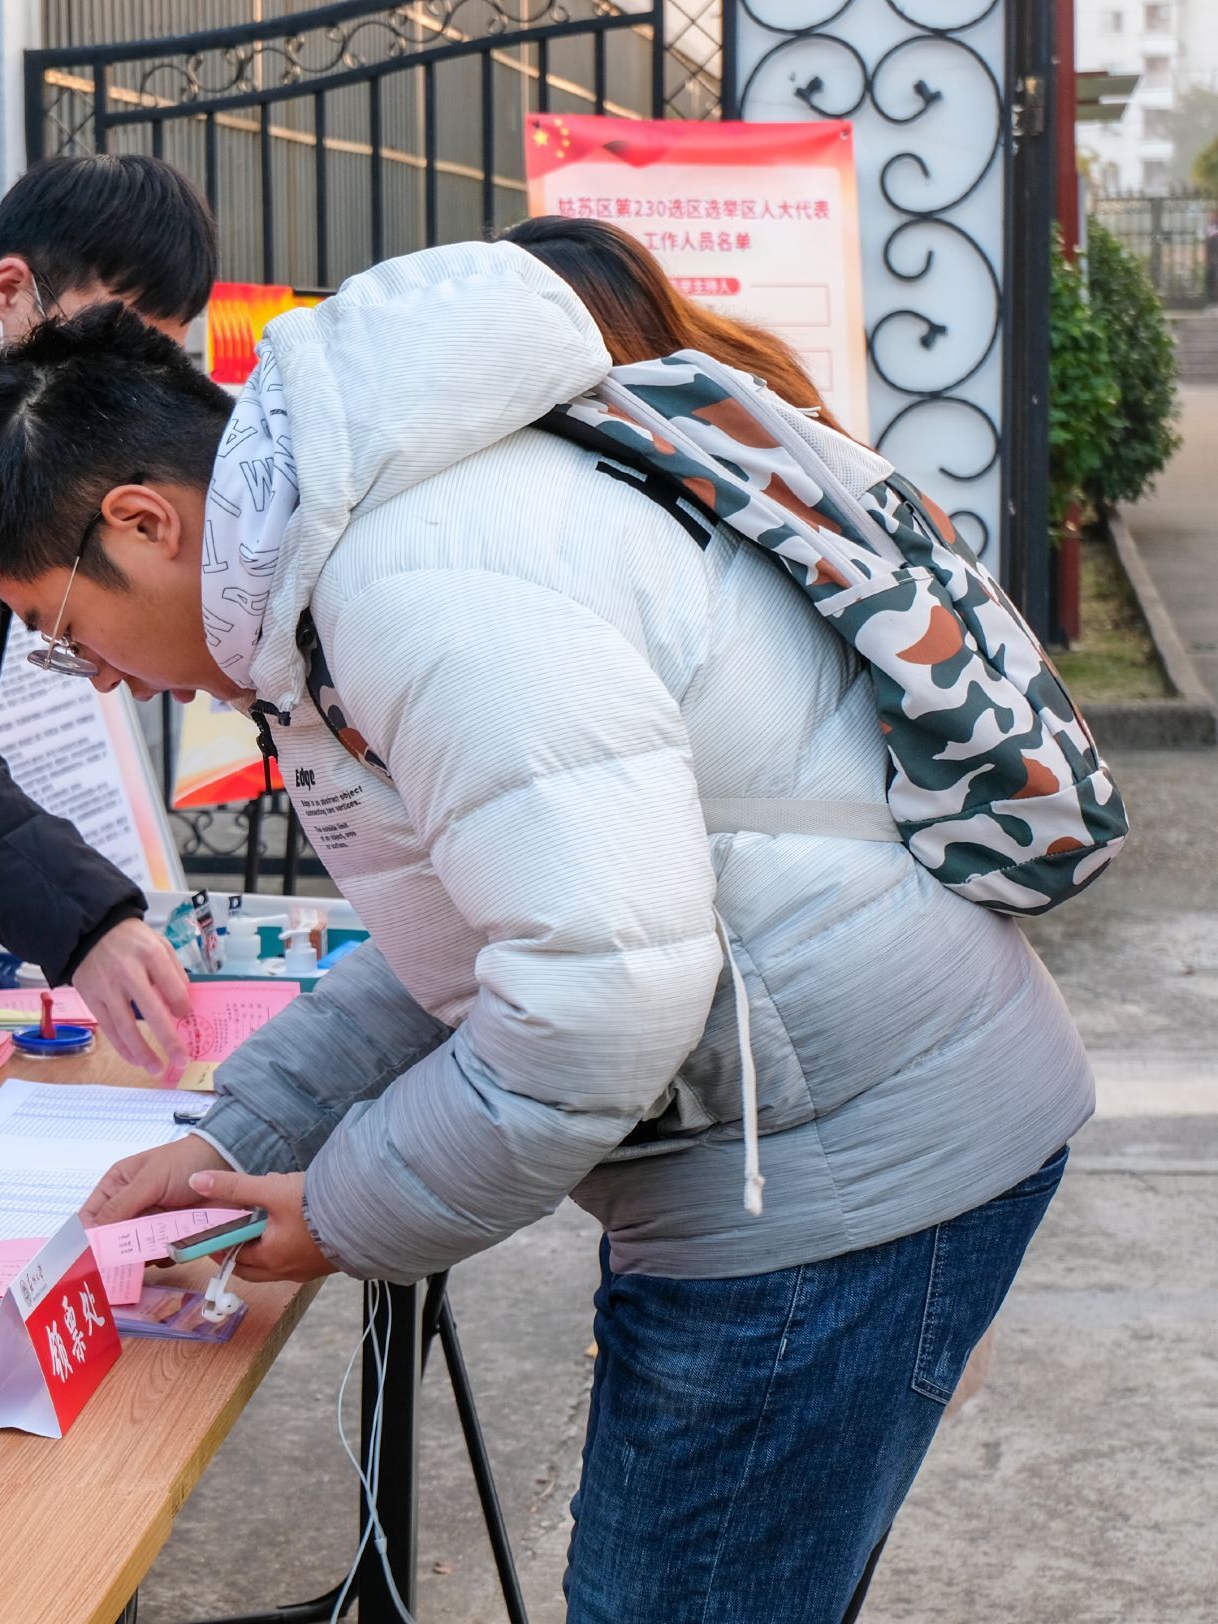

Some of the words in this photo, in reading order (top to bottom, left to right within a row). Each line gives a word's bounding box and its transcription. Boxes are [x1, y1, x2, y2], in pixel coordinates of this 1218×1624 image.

[644, 232, 752, 252] 工作人员名单
[295, 768, 316, 791] Edge
[339, 785, 363, 800] object
